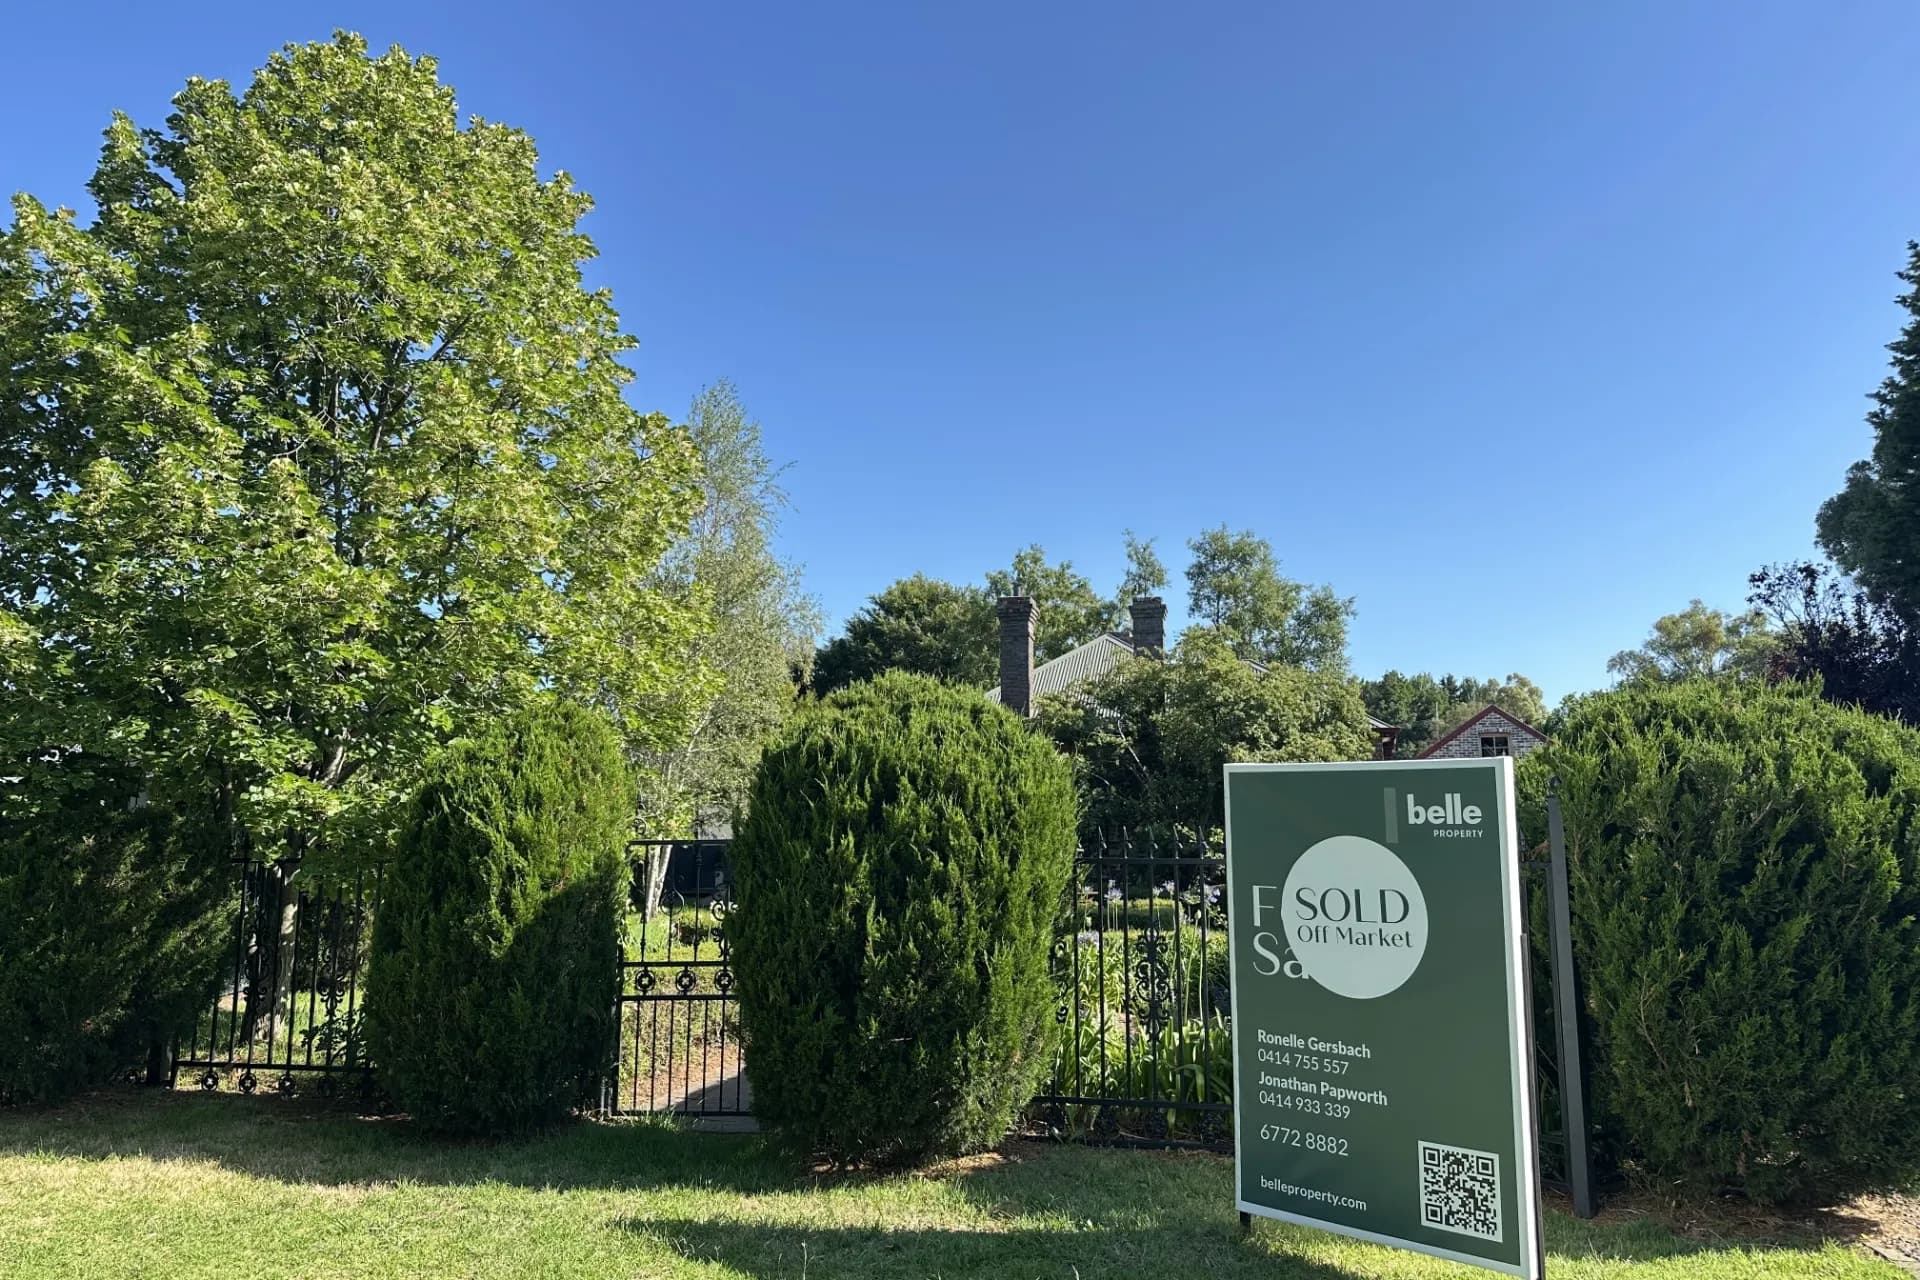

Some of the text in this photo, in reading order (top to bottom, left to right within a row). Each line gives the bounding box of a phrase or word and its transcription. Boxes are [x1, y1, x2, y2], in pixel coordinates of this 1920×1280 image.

[1406, 792, 1482, 825] belle
[1433, 829, 1483, 838] PROPERTY
[1295, 887, 1410, 924] SOLD
[1297, 925, 1413, 948] Off Market
[1252, 931, 1310, 979] Sa
[1257, 1029, 1371, 1059] Ronelle Gersbach
[1257, 1048, 1349, 1075] 0414 755 557
[1258, 1071, 1388, 1106] Jonathan Papworth
[1259, 1090, 1350, 1119] 0414 933 339
[1260, 1124, 1349, 1156] 6772 8882
[1260, 1176, 1367, 1211] belleproperty.com
